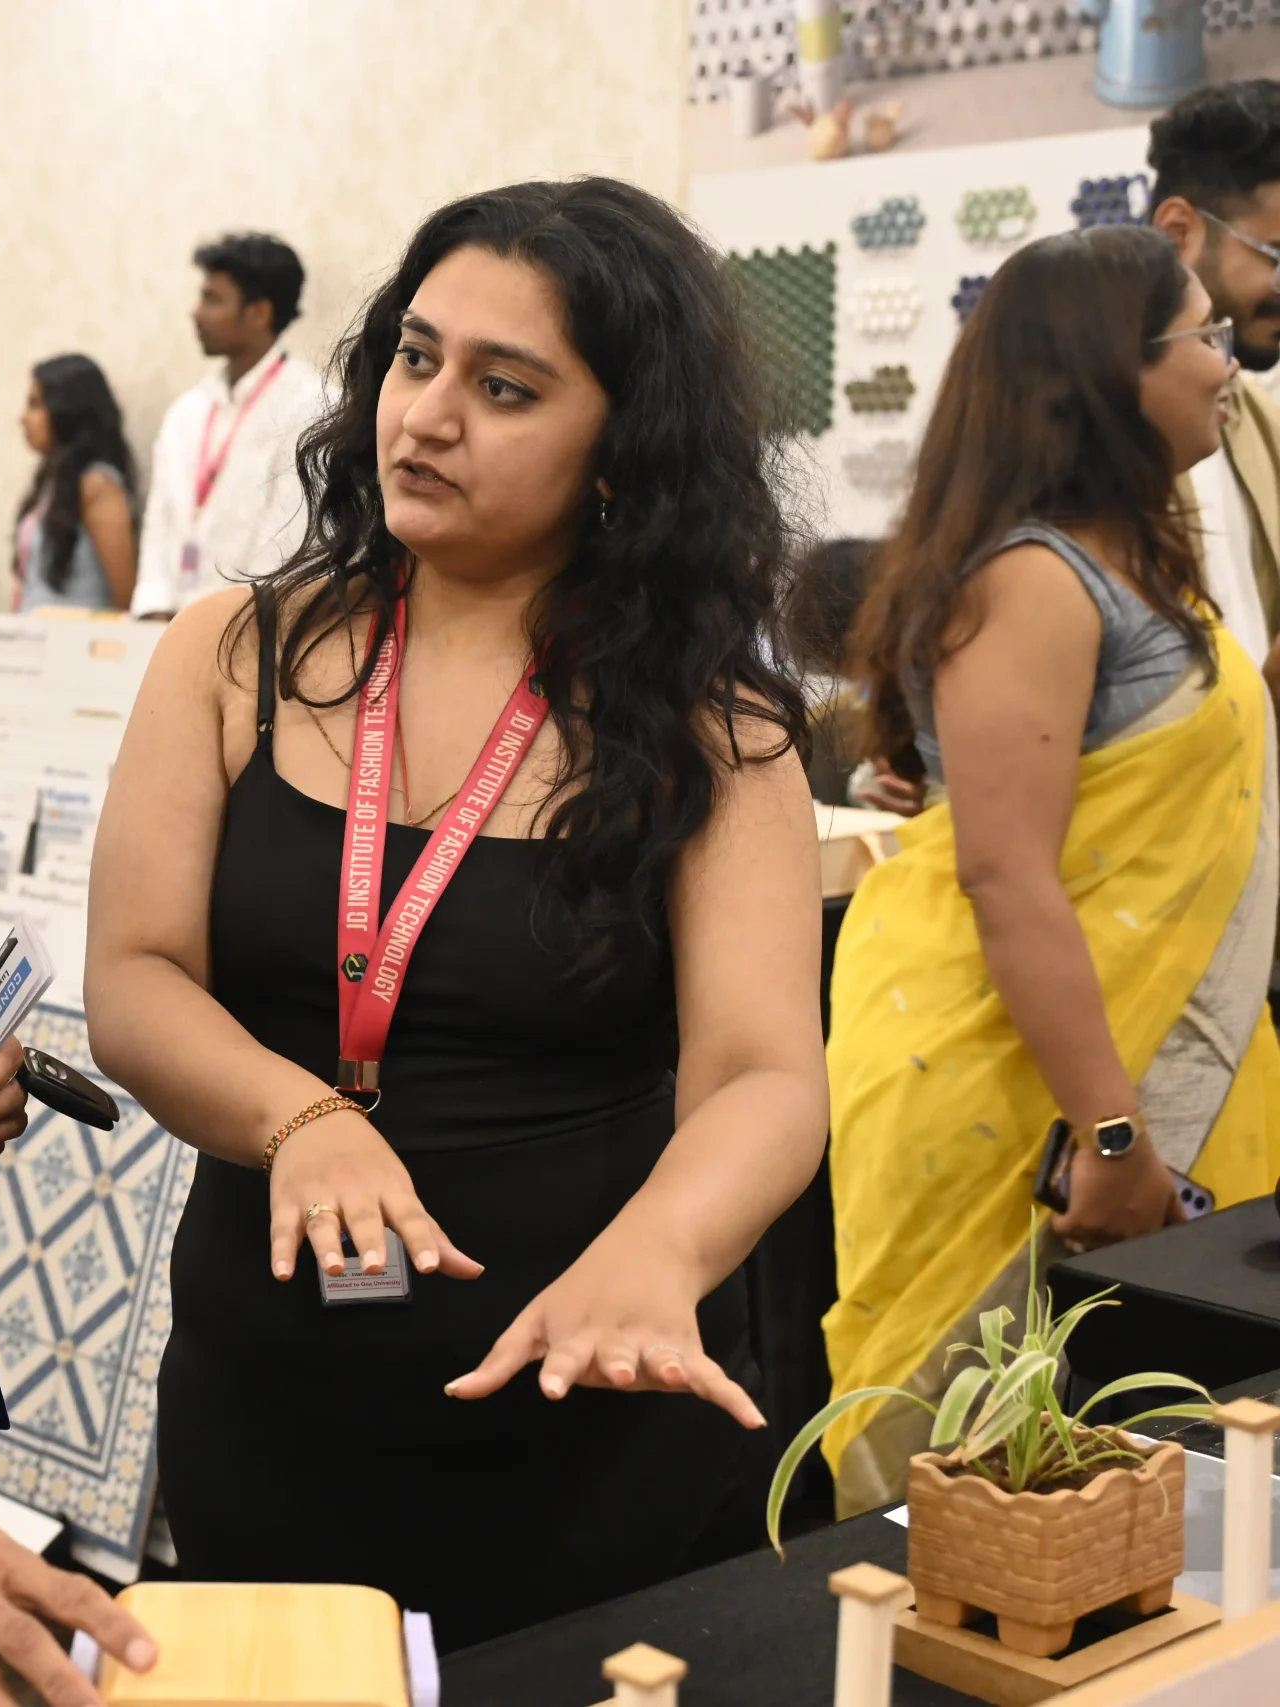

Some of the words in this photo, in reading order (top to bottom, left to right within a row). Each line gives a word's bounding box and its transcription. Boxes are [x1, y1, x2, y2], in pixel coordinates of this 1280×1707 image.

[510, 709, 535, 732] JD
[357, 730, 385, 796] FASHION
[467, 730, 525, 810] INSTITUTE
[355, 799, 378, 819] OF
[456, 807, 481, 829] OF
[347, 823, 376, 907] INSTITUTE
[415, 826, 469, 895] FASHION
[346, 911, 368, 931] JD
[372, 895, 431, 1004] TECHNOLOGY
